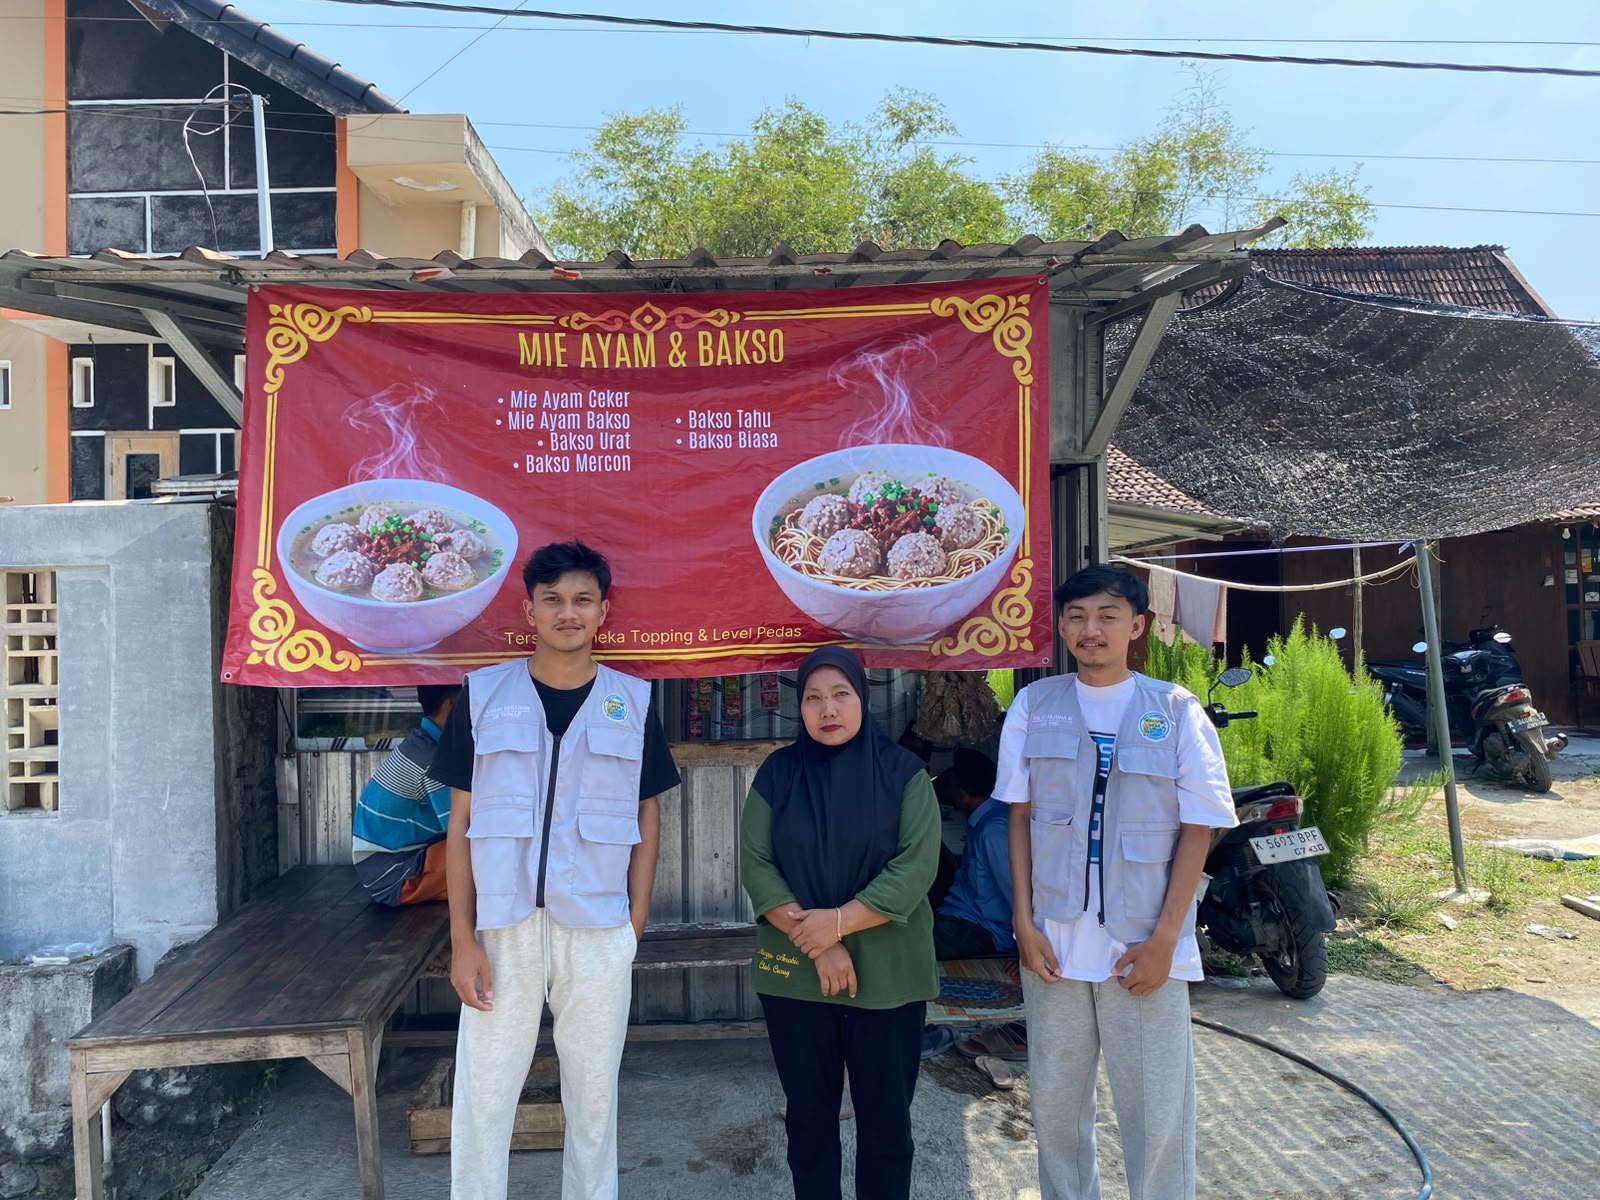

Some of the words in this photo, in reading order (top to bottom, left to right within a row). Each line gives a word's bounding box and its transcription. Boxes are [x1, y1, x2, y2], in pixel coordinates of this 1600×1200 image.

[518, 332, 568, 367] MIE
[580, 332, 656, 368] AYAM
[668, 331, 687, 367] &
[699, 328, 784, 367] BAKSO
[510, 390, 537, 408] Mie
[543, 390, 583, 411] Ayam
[588, 390, 630, 408] Ceker
[508, 411, 534, 430] Mie
[540, 411, 580, 432] Ayam
[587, 411, 631, 429] Bakso
[689, 410, 732, 428] Bakso
[737, 409, 771, 428] Tahu
[550, 432, 593, 451] Bakso
[600, 432, 631, 450] Urat
[689, 431, 733, 449] Bakso
[738, 431, 777, 448] Biasa
[526, 455, 570, 473] Bakso
[576, 454, 631, 472] Mercon
[630, 629, 693, 646] Topping
[698, 629, 708, 641] &
[713, 627, 752, 641] Level
[757, 626, 801, 639] Pedas
[1254, 841, 1263, 850] K
[1297, 830, 1318, 843] BPF
